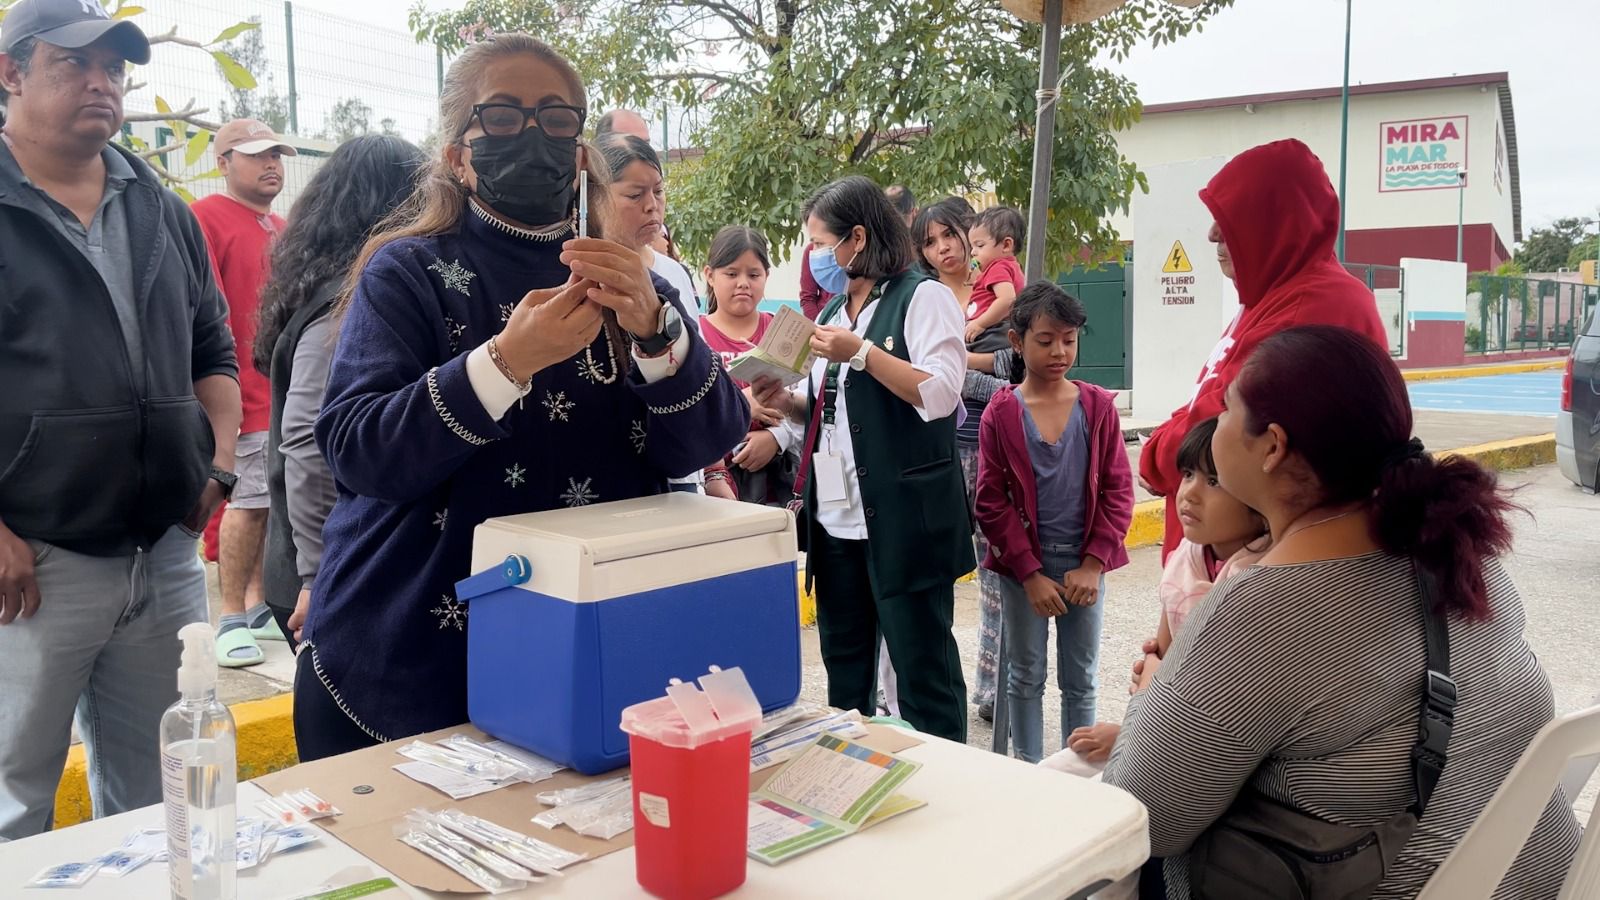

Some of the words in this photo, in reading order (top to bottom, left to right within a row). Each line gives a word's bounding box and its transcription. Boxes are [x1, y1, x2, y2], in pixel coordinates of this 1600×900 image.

[1387, 121, 1460, 144] MIRA
[1386, 143, 1447, 165] MAR
[1397, 164, 1419, 172] PLAYA
[1161, 276, 1195, 285] PELIGRO
[1165, 286, 1188, 294] ALTA
[1162, 296, 1195, 305] TENSION
